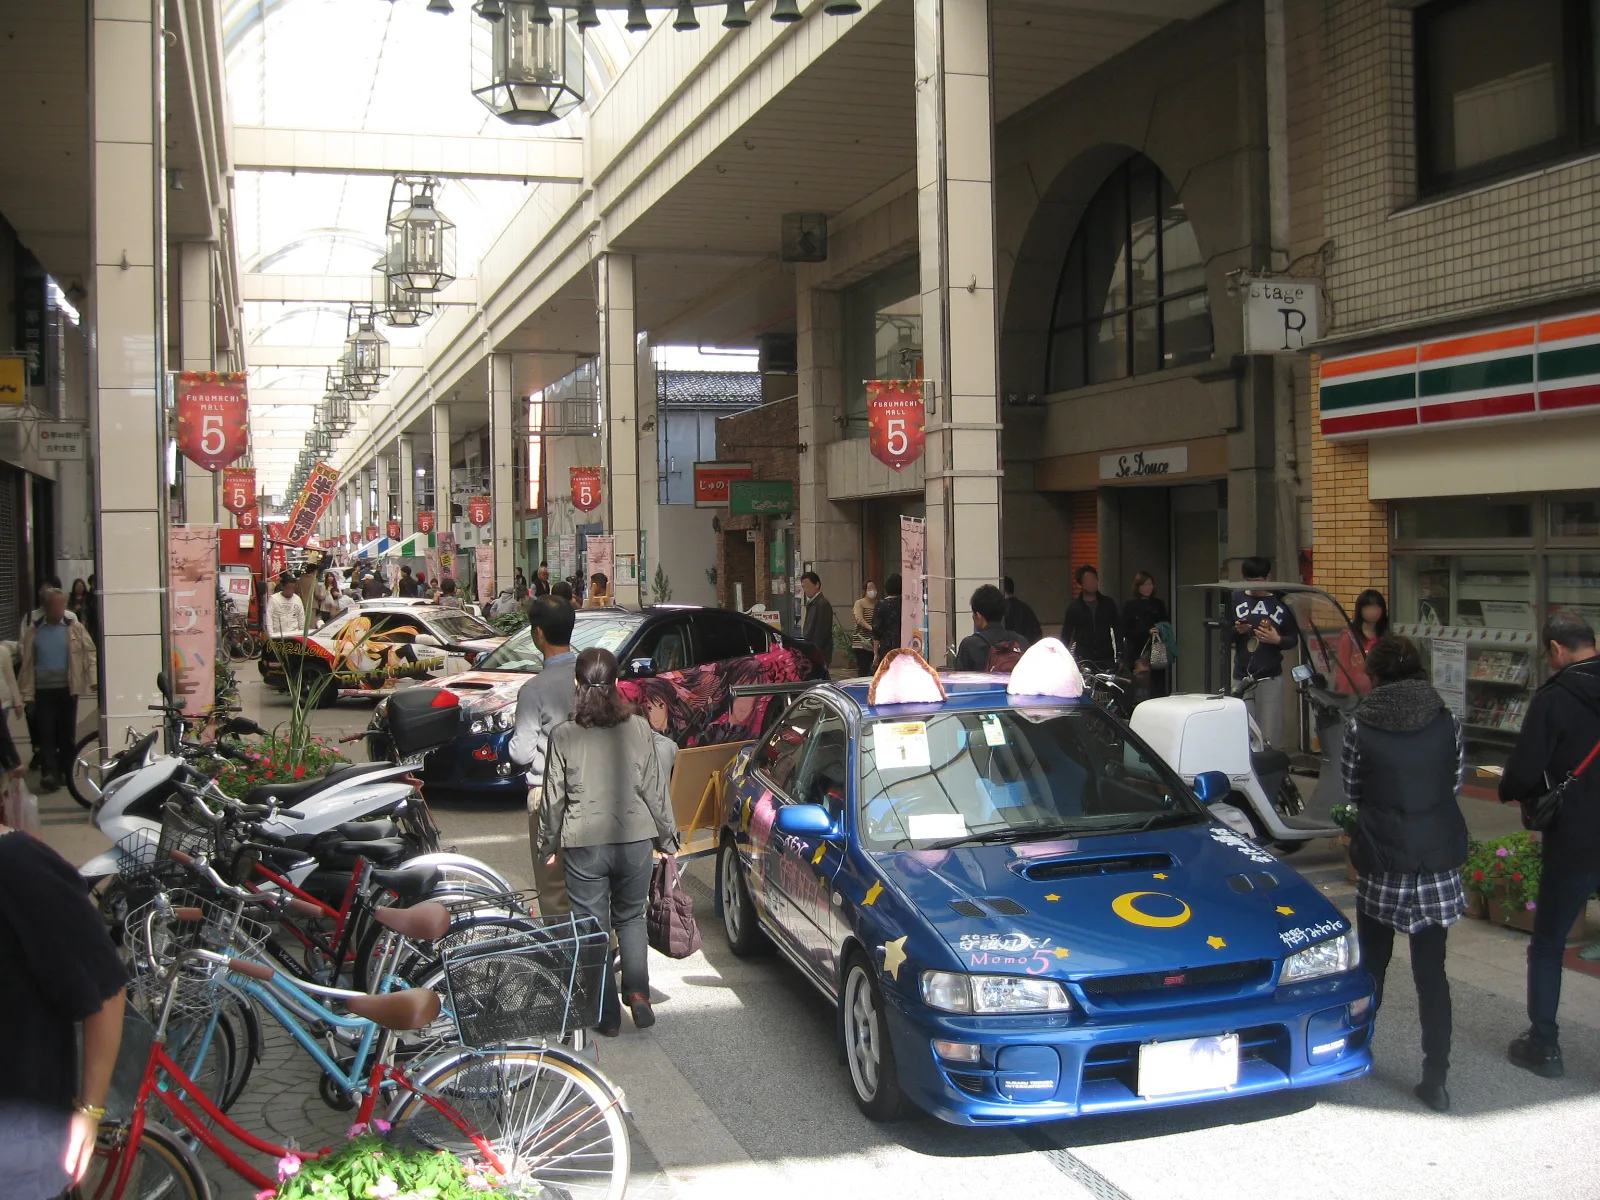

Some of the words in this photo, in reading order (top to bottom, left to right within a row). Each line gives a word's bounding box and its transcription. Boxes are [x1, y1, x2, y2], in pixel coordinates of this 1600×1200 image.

[1251, 284, 1303, 304] stage
[186, 394, 240, 403] FURUMACHI
[873, 400, 918, 408] FURUMACHI
[201, 415, 226, 455] 5
[887, 419, 909, 455] 5
[233, 488, 247, 508] 5
[580, 486, 592, 506] 5
[243, 512, 252, 526] 5
[422, 521, 429, 531] 5
[475, 509, 484, 523] 5
[174, 588, 197, 631] 5
[1235, 600, 1284, 625] CAL
